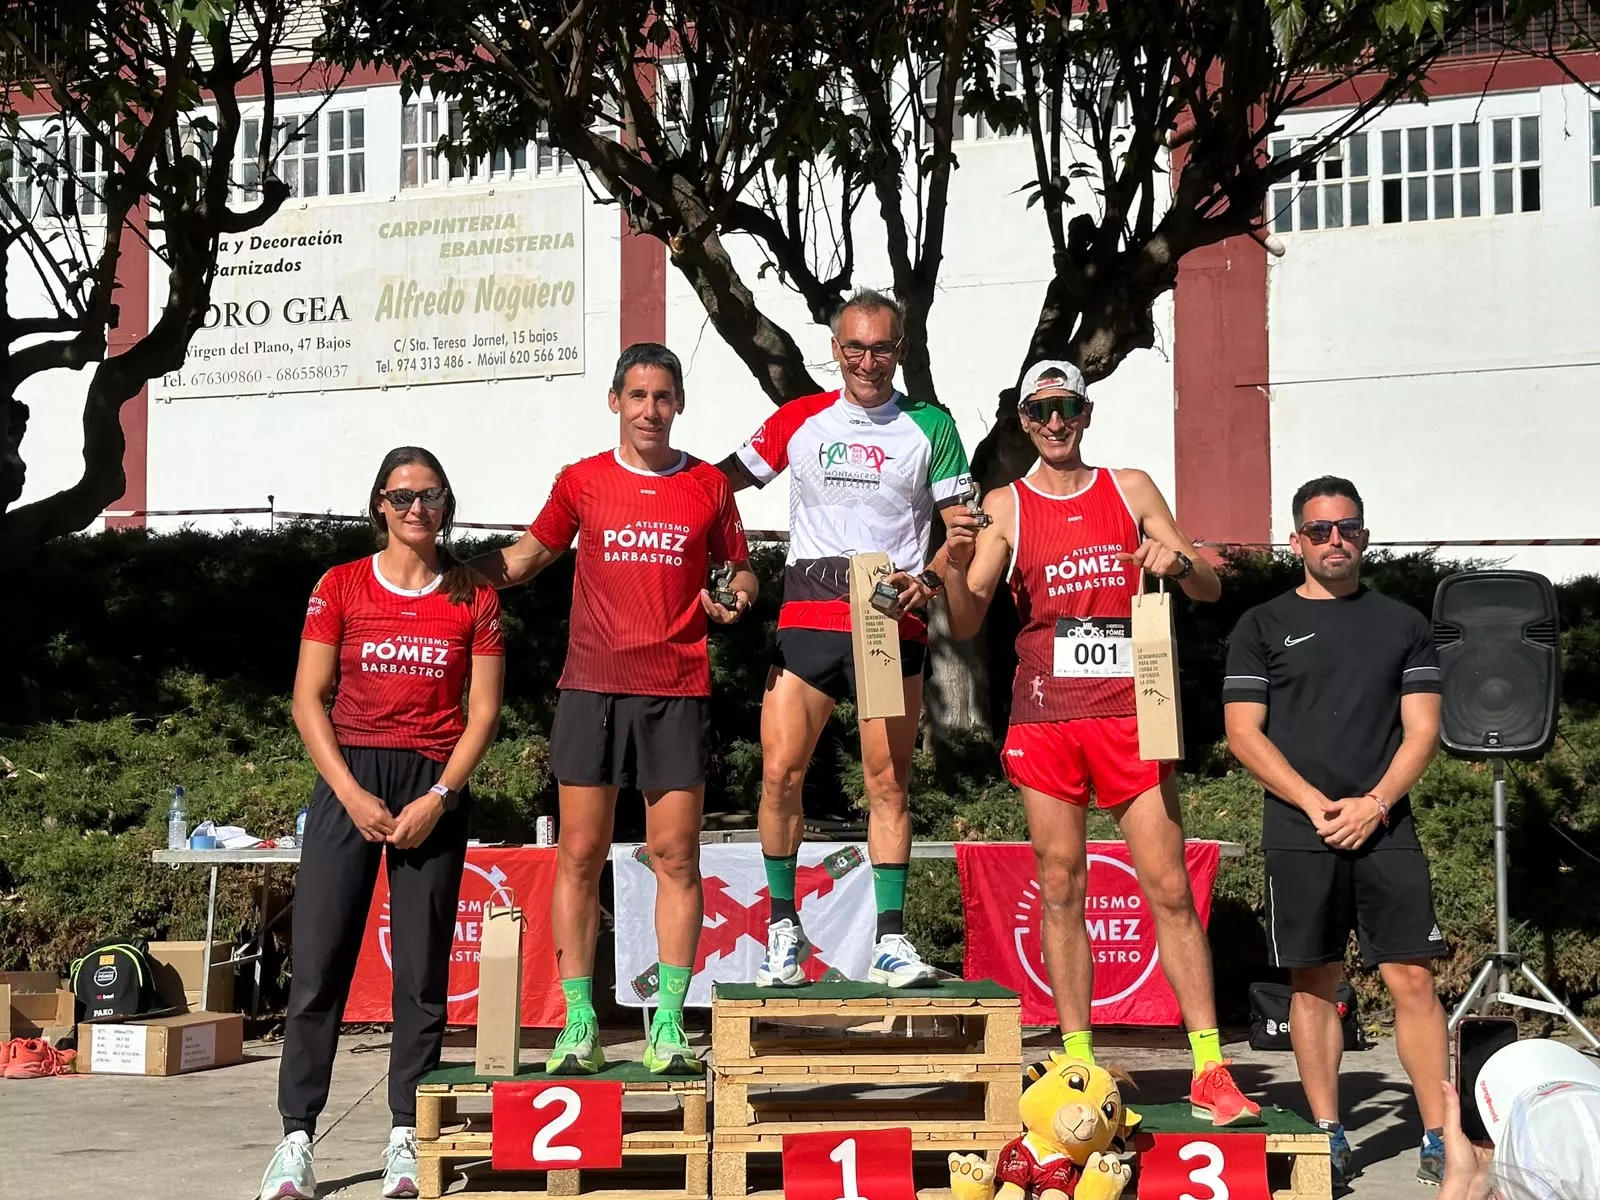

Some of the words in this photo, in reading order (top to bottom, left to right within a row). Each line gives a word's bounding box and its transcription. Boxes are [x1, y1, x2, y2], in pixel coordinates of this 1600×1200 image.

[378, 213, 516, 239] CARPINTERIA
[234, 240, 243, 254] y
[250, 230, 343, 250] Decoración
[439, 232, 575, 258] EBANISTERIA
[283, 295, 351, 324] GEA
[375, 276, 465, 322] Alfredo
[475, 274, 575, 321] Noguero
[230, 342, 249, 355] del
[254, 340, 293, 354] Plano,
[298, 338, 311, 351] 47
[316, 336, 351, 352] Bajos
[394, 338, 407, 353] C/
[410, 338, 429, 352] Sta.
[433, 336, 466, 350] Teresa
[473, 334, 509, 348] Jornet,
[513, 331, 525, 344] 15
[529, 328, 558, 346] bajos
[376, 360, 393, 373] Tel.
[397, 358, 416, 372] 974
[421, 356, 440, 370] 313
[444, 355, 464, 369] 486
[478, 352, 506, 367] Móvil
[509, 350, 530, 364] 620
[534, 348, 554, 362] 566
[558, 346, 578, 361] 206
[162, 371, 186, 387] Tel.
[191, 369, 262, 386] 676309860
[276, 365, 348, 381] 686558037
[824, 480, 880, 490] BARBASTRO
[825, 471, 881, 481] MONTAÑEROS
[603, 524, 688, 552] PÓMEZ
[635, 520, 690, 533] ATLETISMO
[604, 551, 682, 566] BARBASTRO
[1072, 544, 1122, 558] ATLETISMO
[1044, 554, 1124, 583] PÓMEZ
[1048, 576, 1126, 597] BARBASTRO
[361, 638, 449, 665] PÓMEZ
[395, 635, 449, 647] ATLETISMO
[1075, 643, 1117, 665] 001
[361, 662, 444, 679] BARBASTRO
[1085, 918, 1141, 941] MEZ
[532, 1086, 582, 1161] 2
[829, 1138, 871, 1200] 1
[1178, 1141, 1229, 1200] 3
